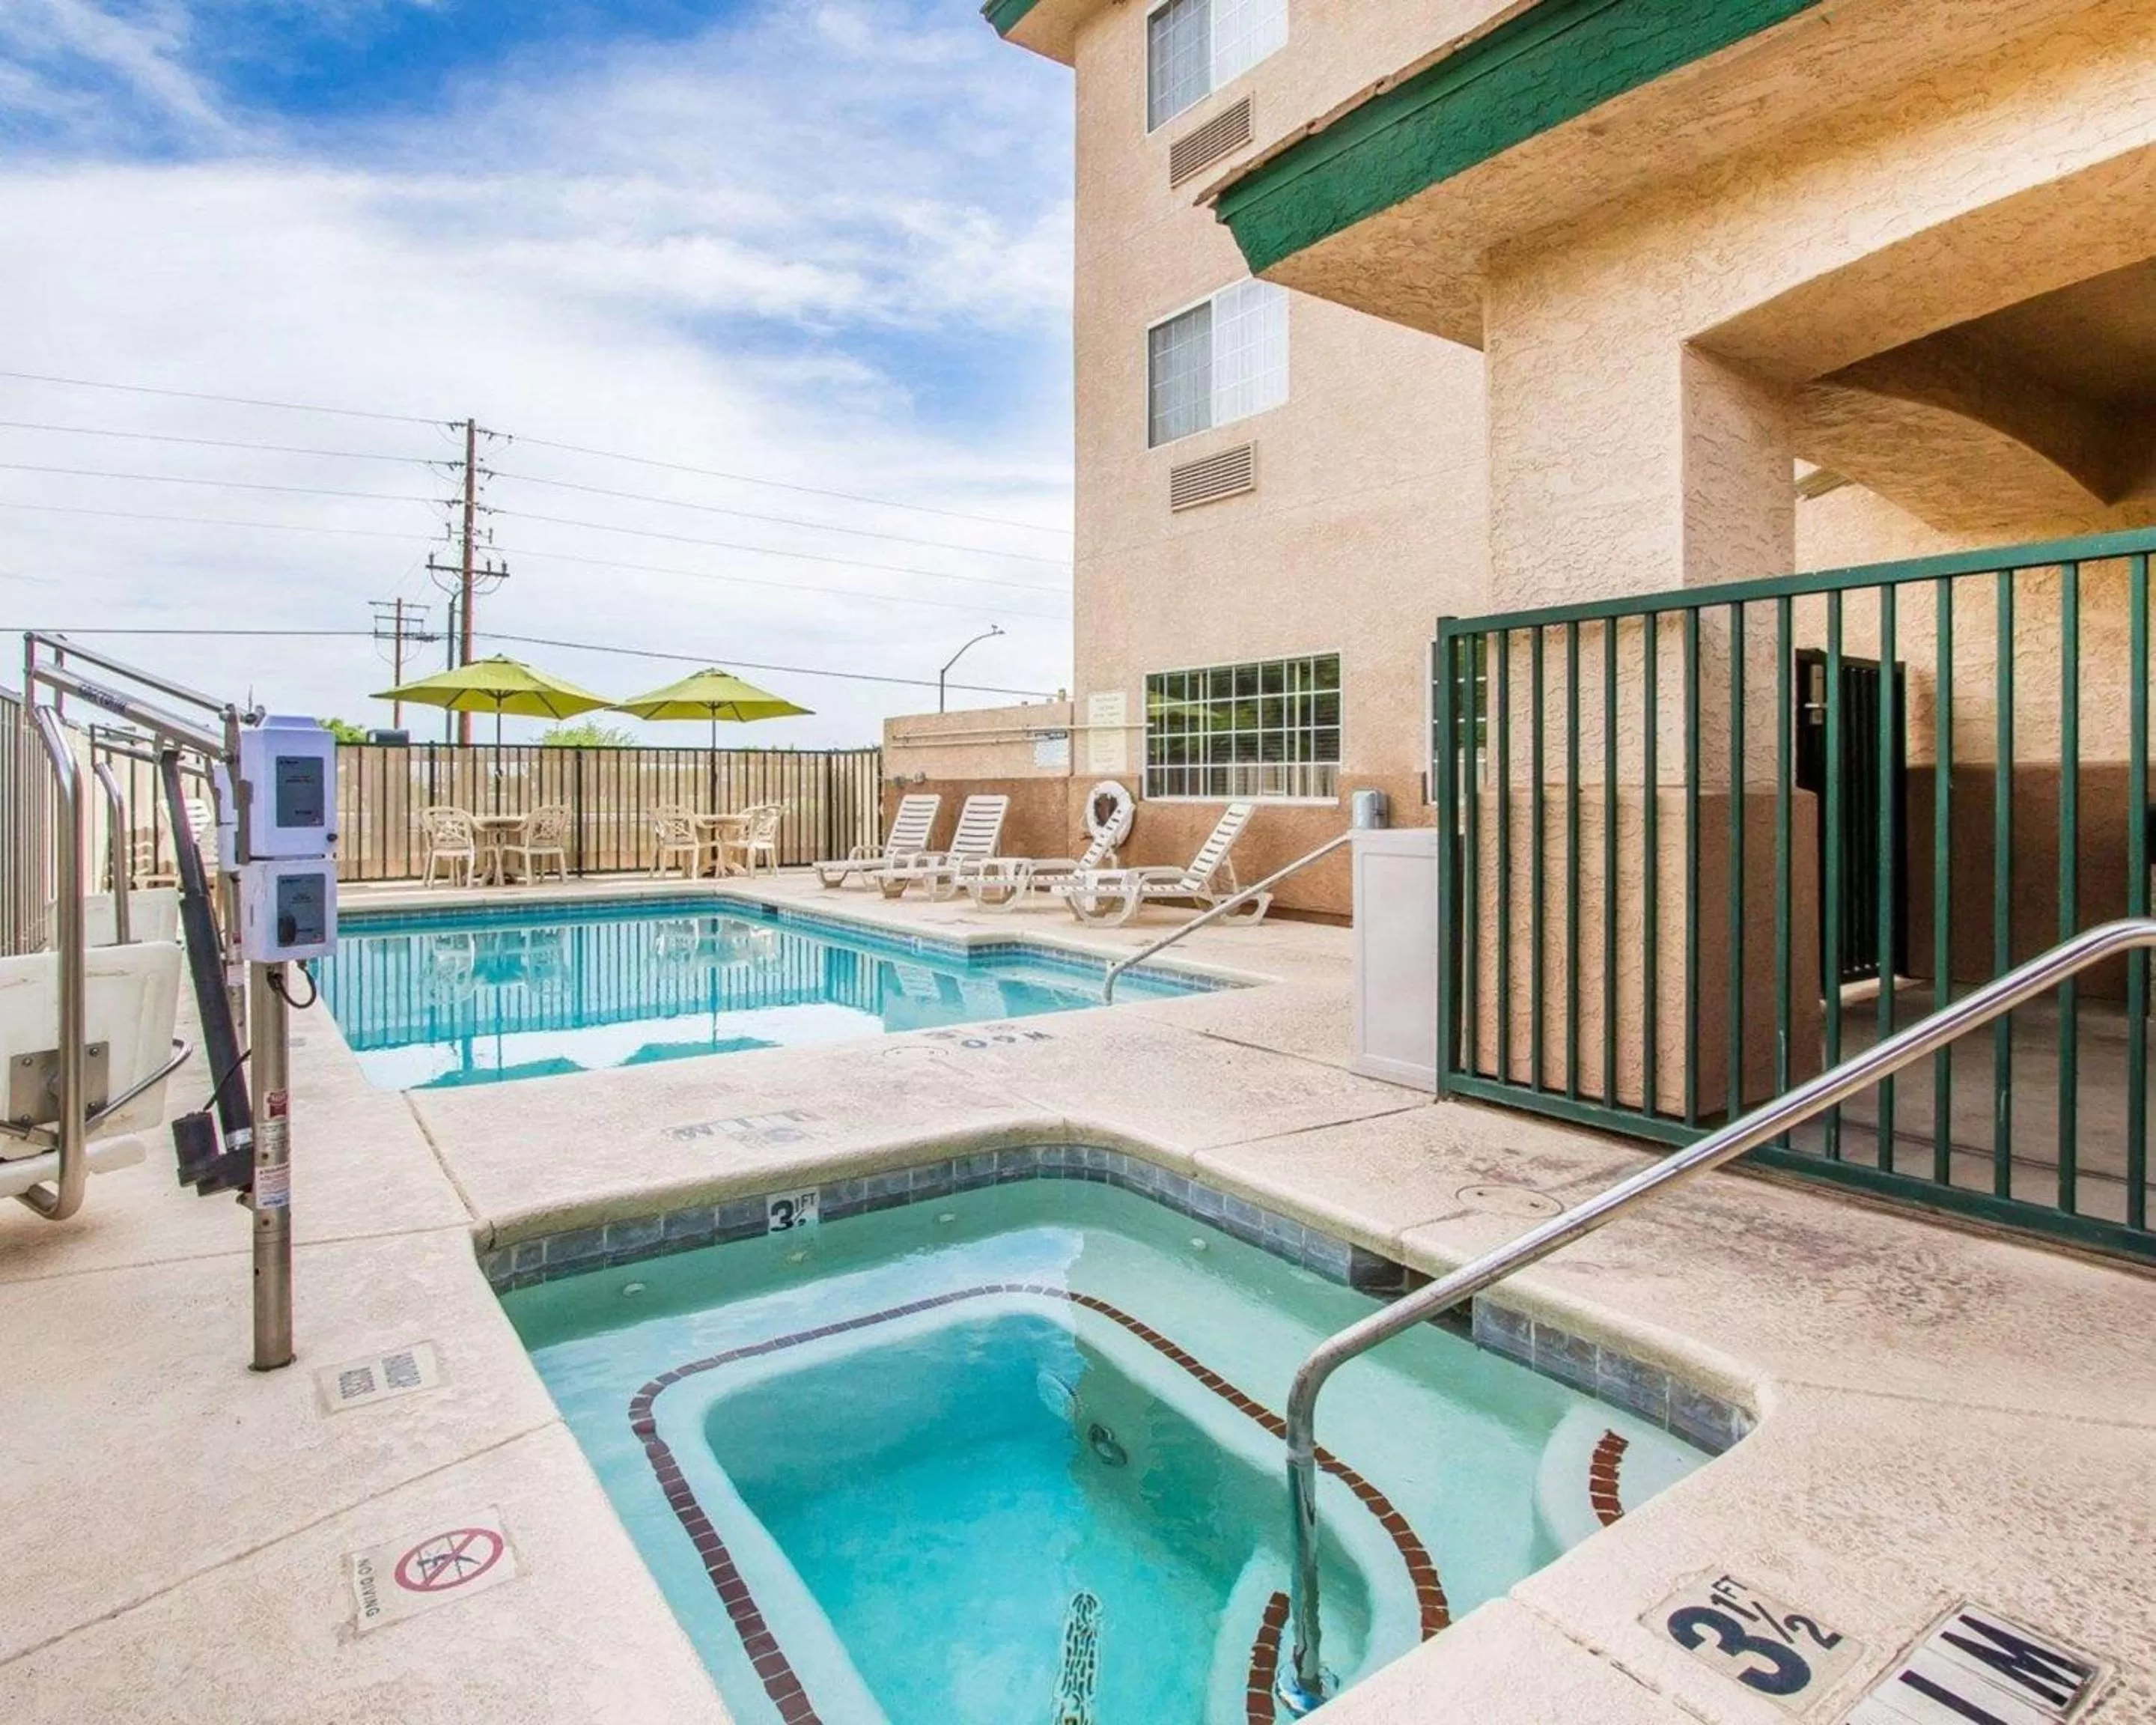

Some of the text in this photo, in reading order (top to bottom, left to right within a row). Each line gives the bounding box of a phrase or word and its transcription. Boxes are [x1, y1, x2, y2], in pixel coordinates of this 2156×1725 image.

[770, 1199, 794, 1232] 3
[801, 1192, 816, 1208] FT
[358, 1558, 380, 1618] NO DIVING
[1711, 1575, 1748, 1599] FT
[1667, 1606, 1812, 1695] 3
